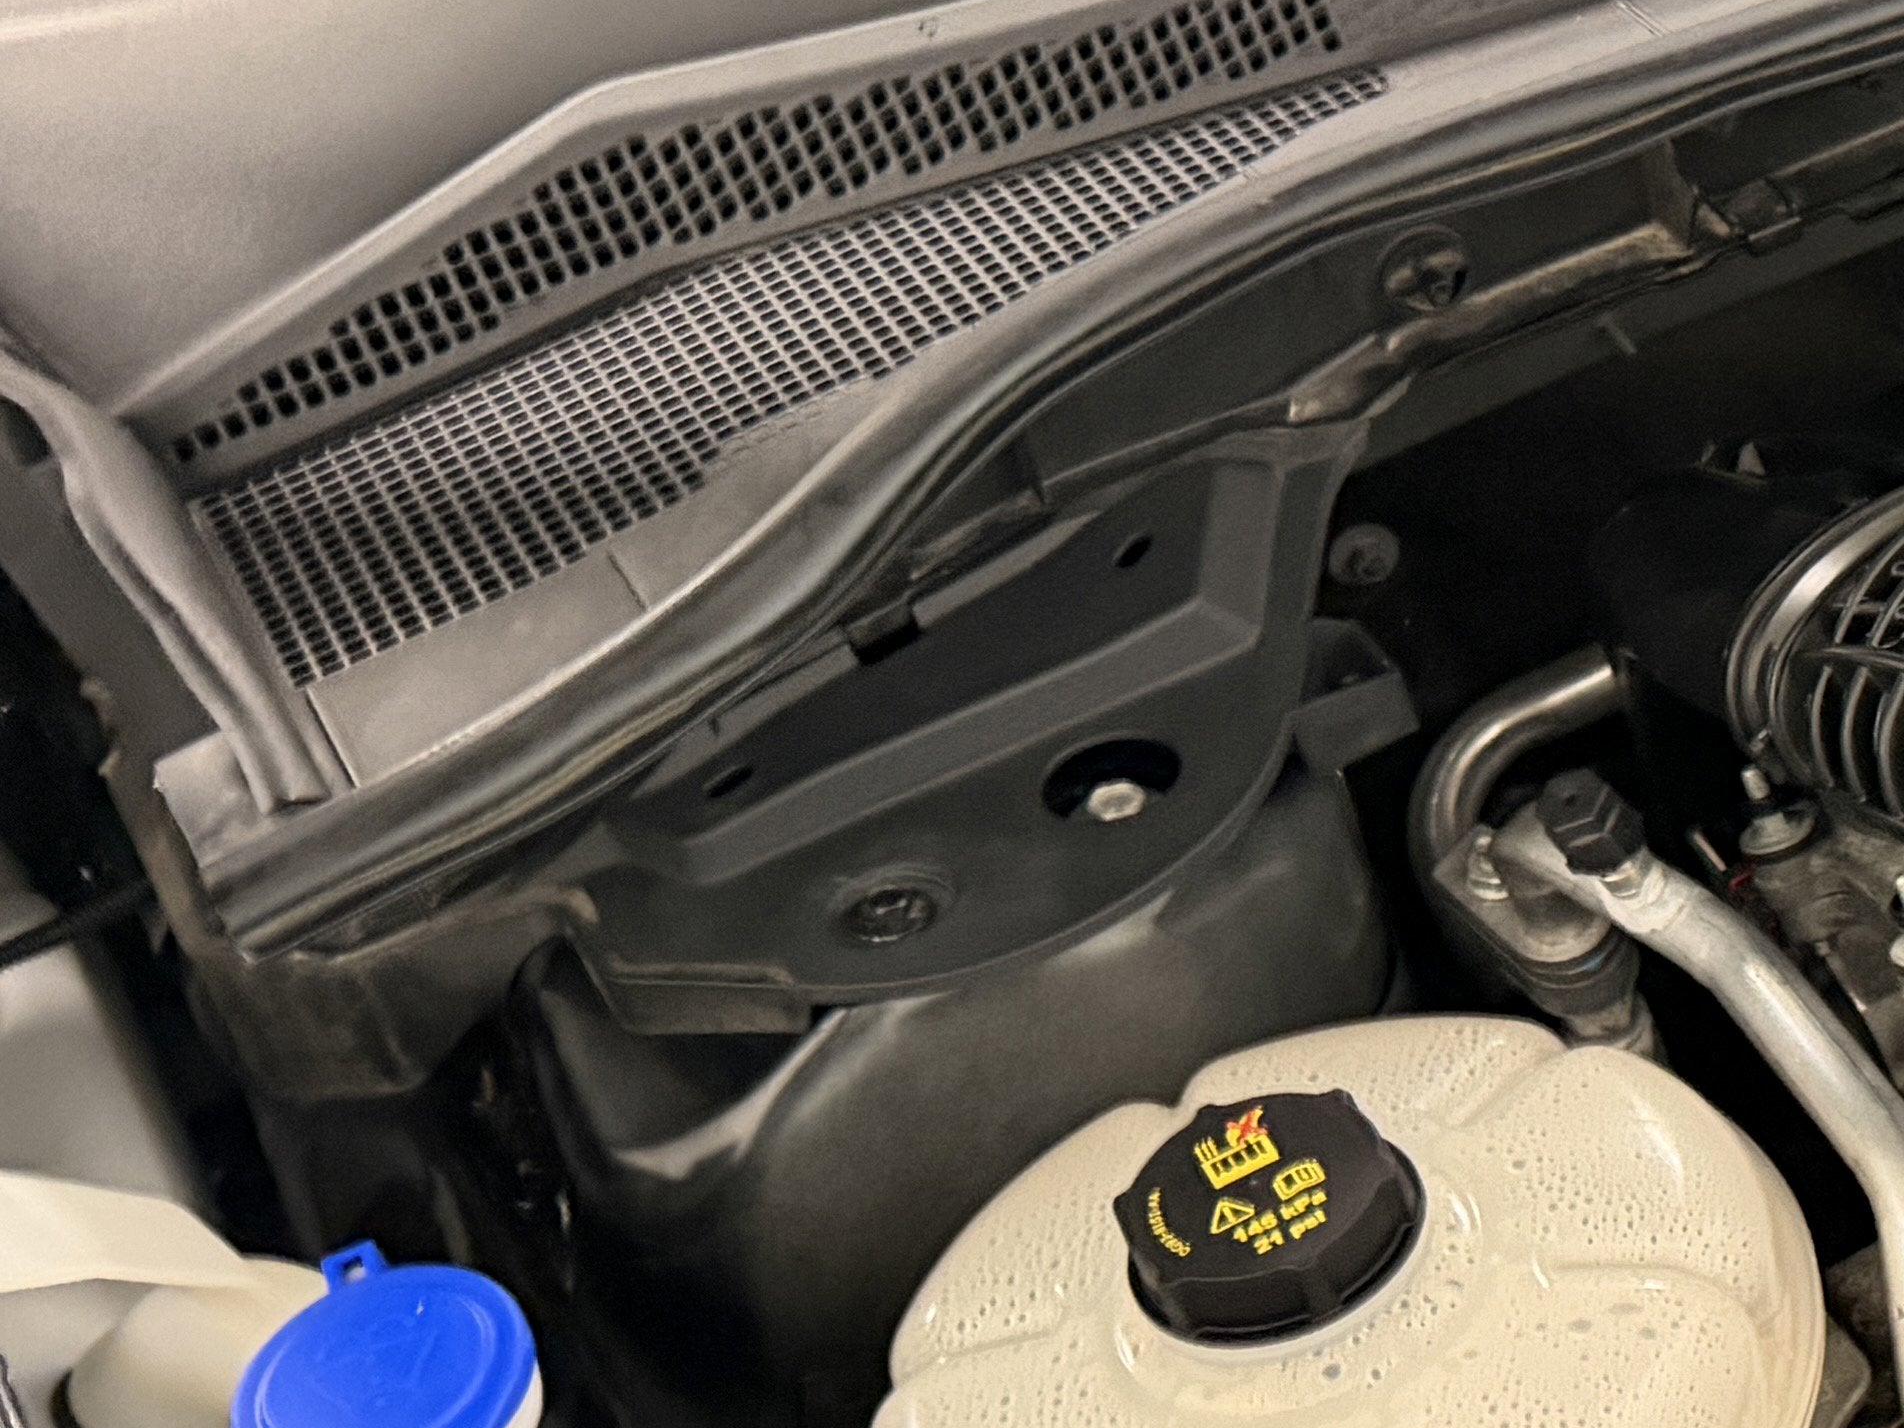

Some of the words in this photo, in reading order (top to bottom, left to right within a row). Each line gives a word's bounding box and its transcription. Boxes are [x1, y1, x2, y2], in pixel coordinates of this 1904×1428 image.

[1233, 1210, 1278, 1243] 145
[1280, 1189, 1328, 1220] kPa
[1253, 1228, 1285, 1256] 21
